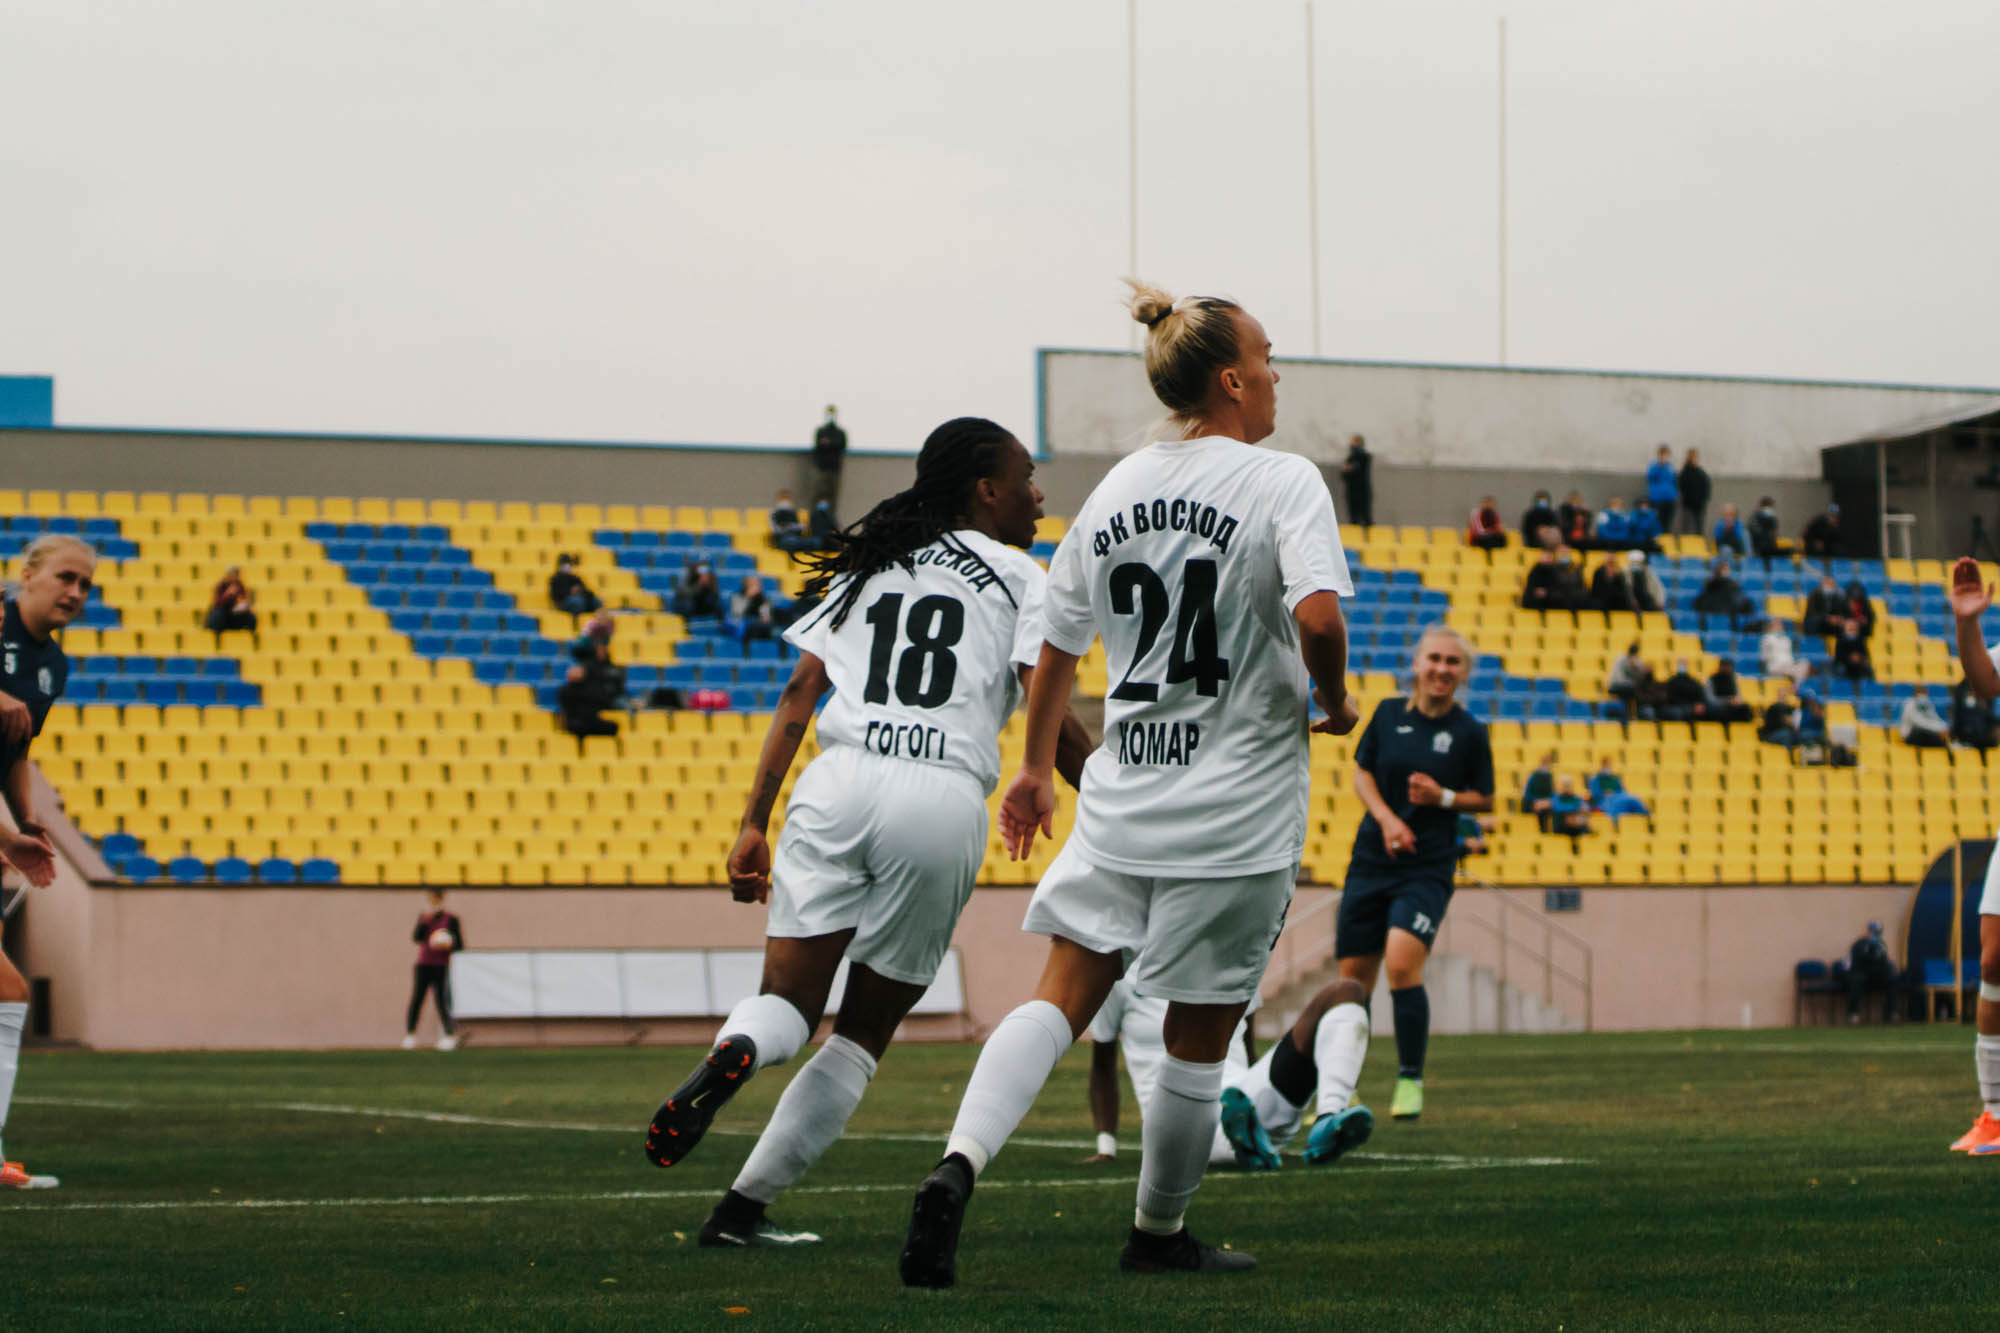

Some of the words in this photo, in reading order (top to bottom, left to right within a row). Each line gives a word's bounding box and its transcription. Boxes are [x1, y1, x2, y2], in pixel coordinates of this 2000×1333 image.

[1093, 512, 1130, 557] ФК
[1133, 499, 1238, 554] ВОСХОД
[906, 548, 997, 593] ОСХОД
[863, 592, 965, 709] 18
[1108, 559, 1230, 702] 24
[1118, 720, 1200, 766] ХОМАР
